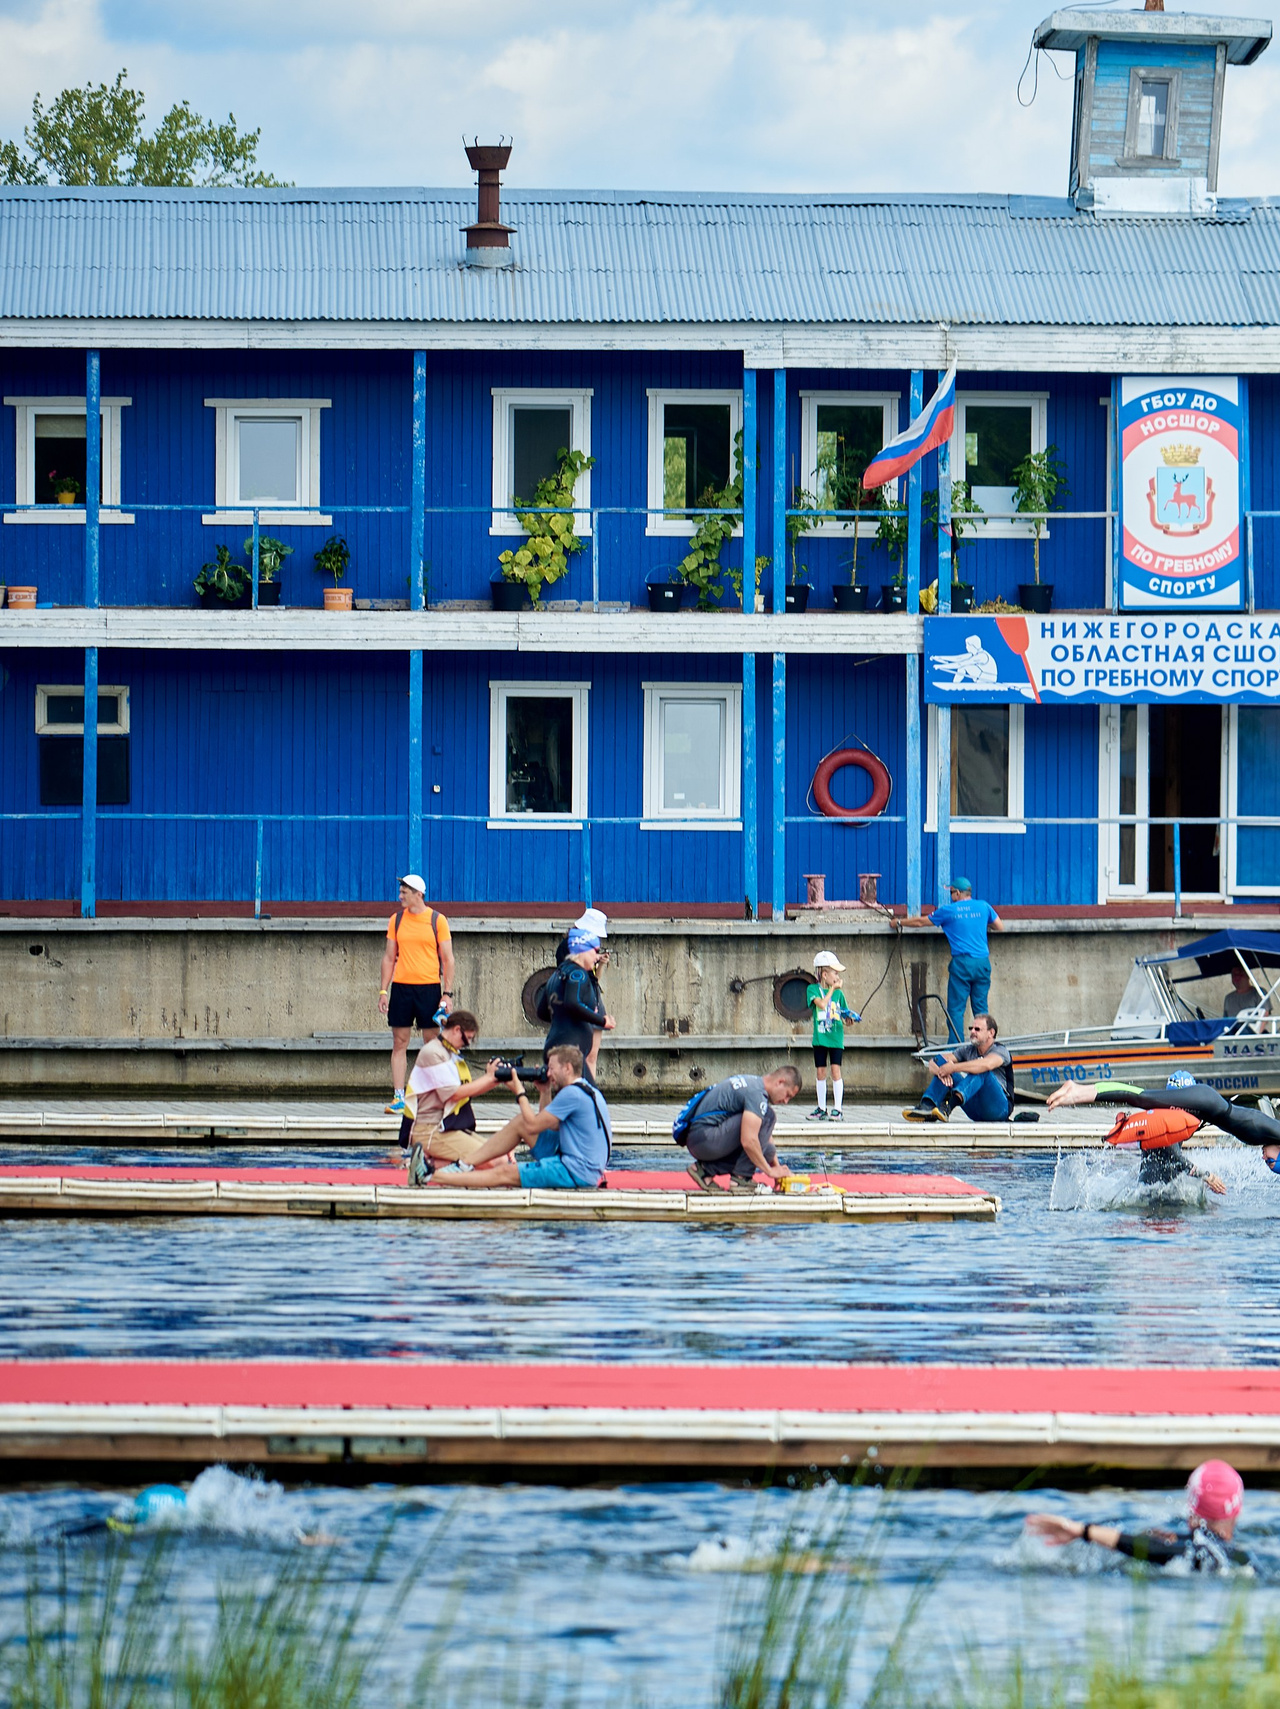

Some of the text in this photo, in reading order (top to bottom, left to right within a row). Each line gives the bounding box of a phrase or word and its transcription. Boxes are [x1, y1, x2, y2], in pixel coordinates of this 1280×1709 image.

[1140, 392, 1218, 413] ГБОУ ДО
[1140, 414, 1221, 436] НОСШОР
[1130, 541, 1234, 573] ПО ГРЕБНОМУ
[1148, 575, 1217, 596] СПОРТУ
[1050, 644, 1205, 663] ОБЛАСТНАЯ
[1041, 668, 1076, 687] ПО
[1084, 668, 1205, 687] ГРЕБНОМУ
[1206, 1076, 1259, 1090] РОССИИ
